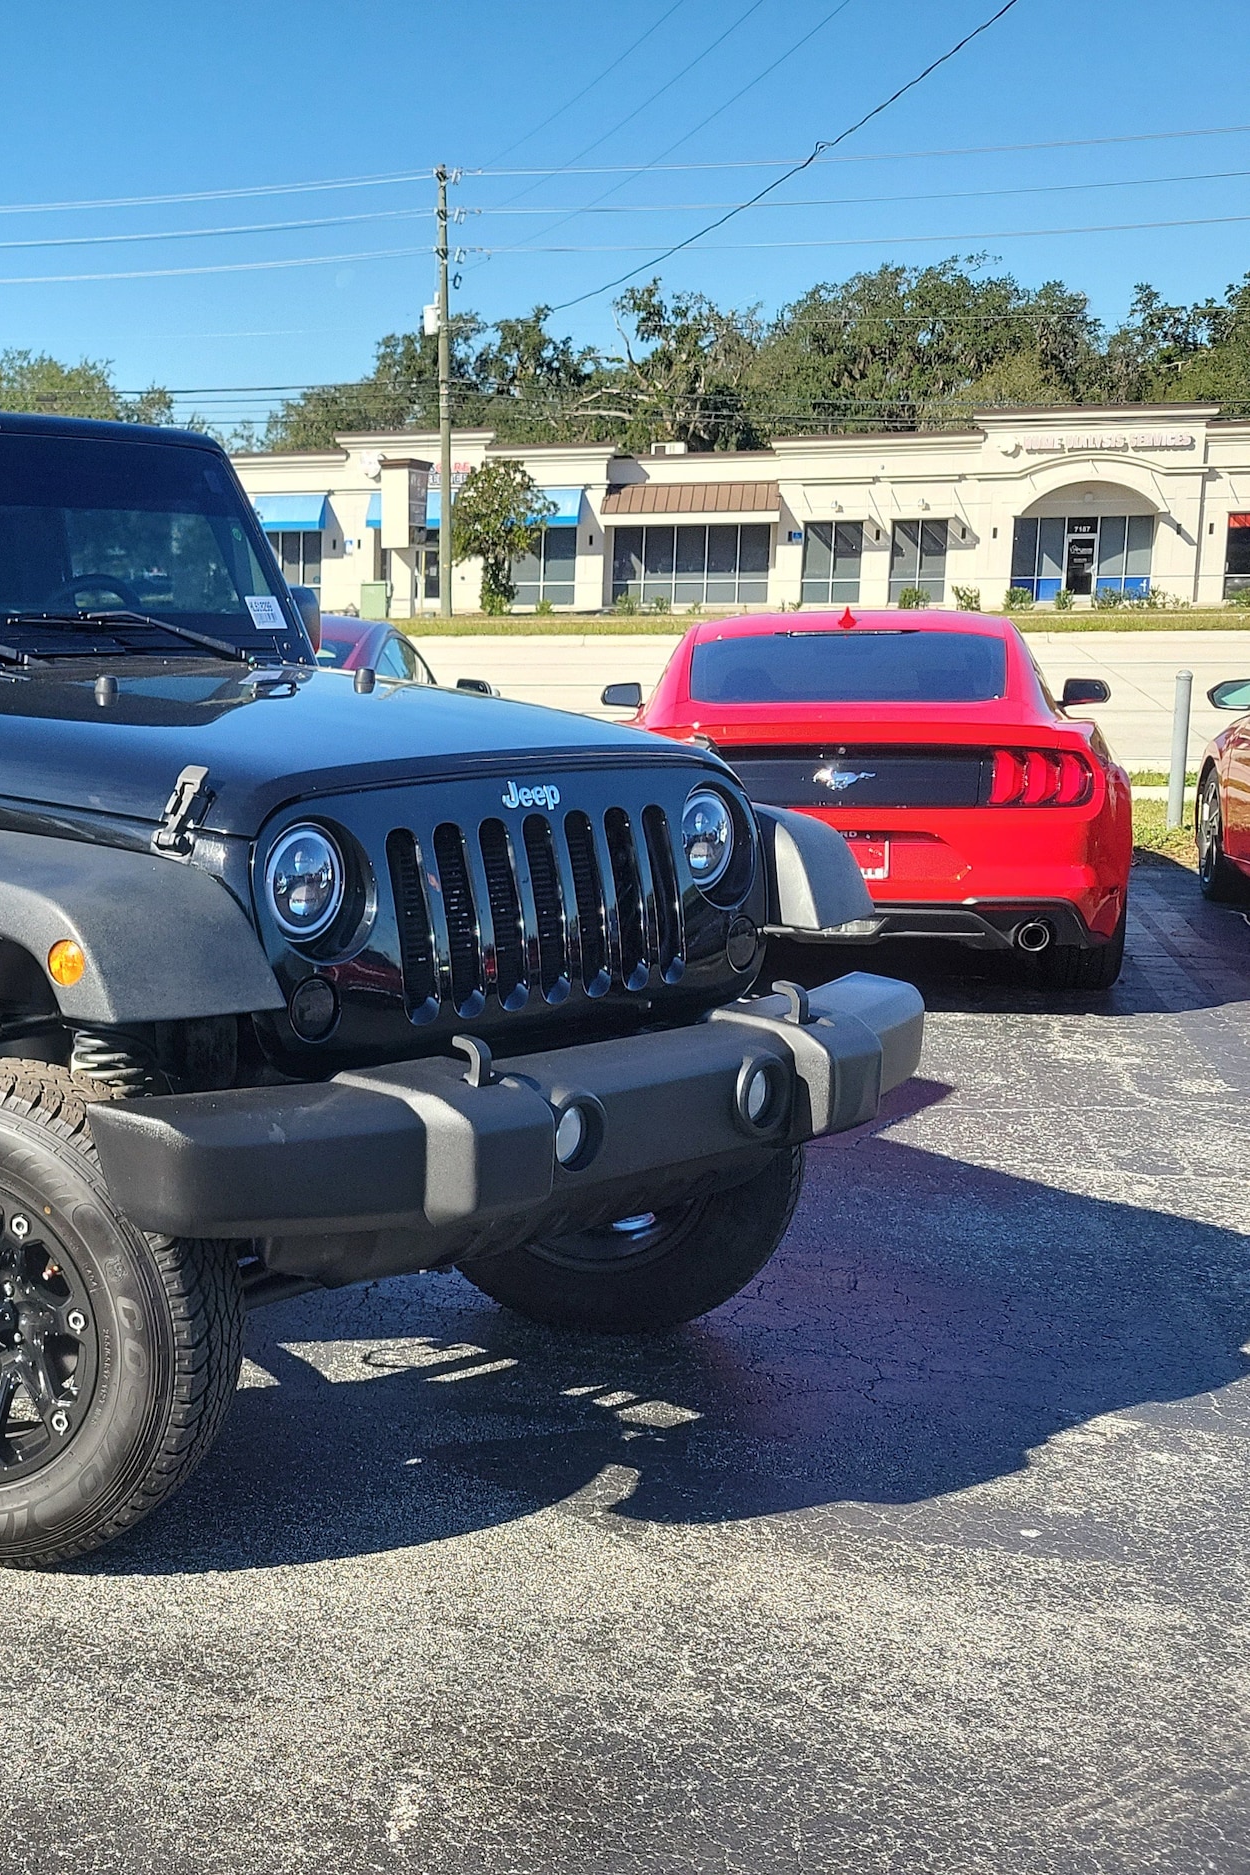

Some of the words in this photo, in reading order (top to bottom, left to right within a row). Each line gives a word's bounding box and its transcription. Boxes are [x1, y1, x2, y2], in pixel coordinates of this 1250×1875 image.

[1128, 431, 1192, 448] SERVICES
[501, 780, 561, 811] Jeep
[78, 1296, 148, 1500] COSMO
